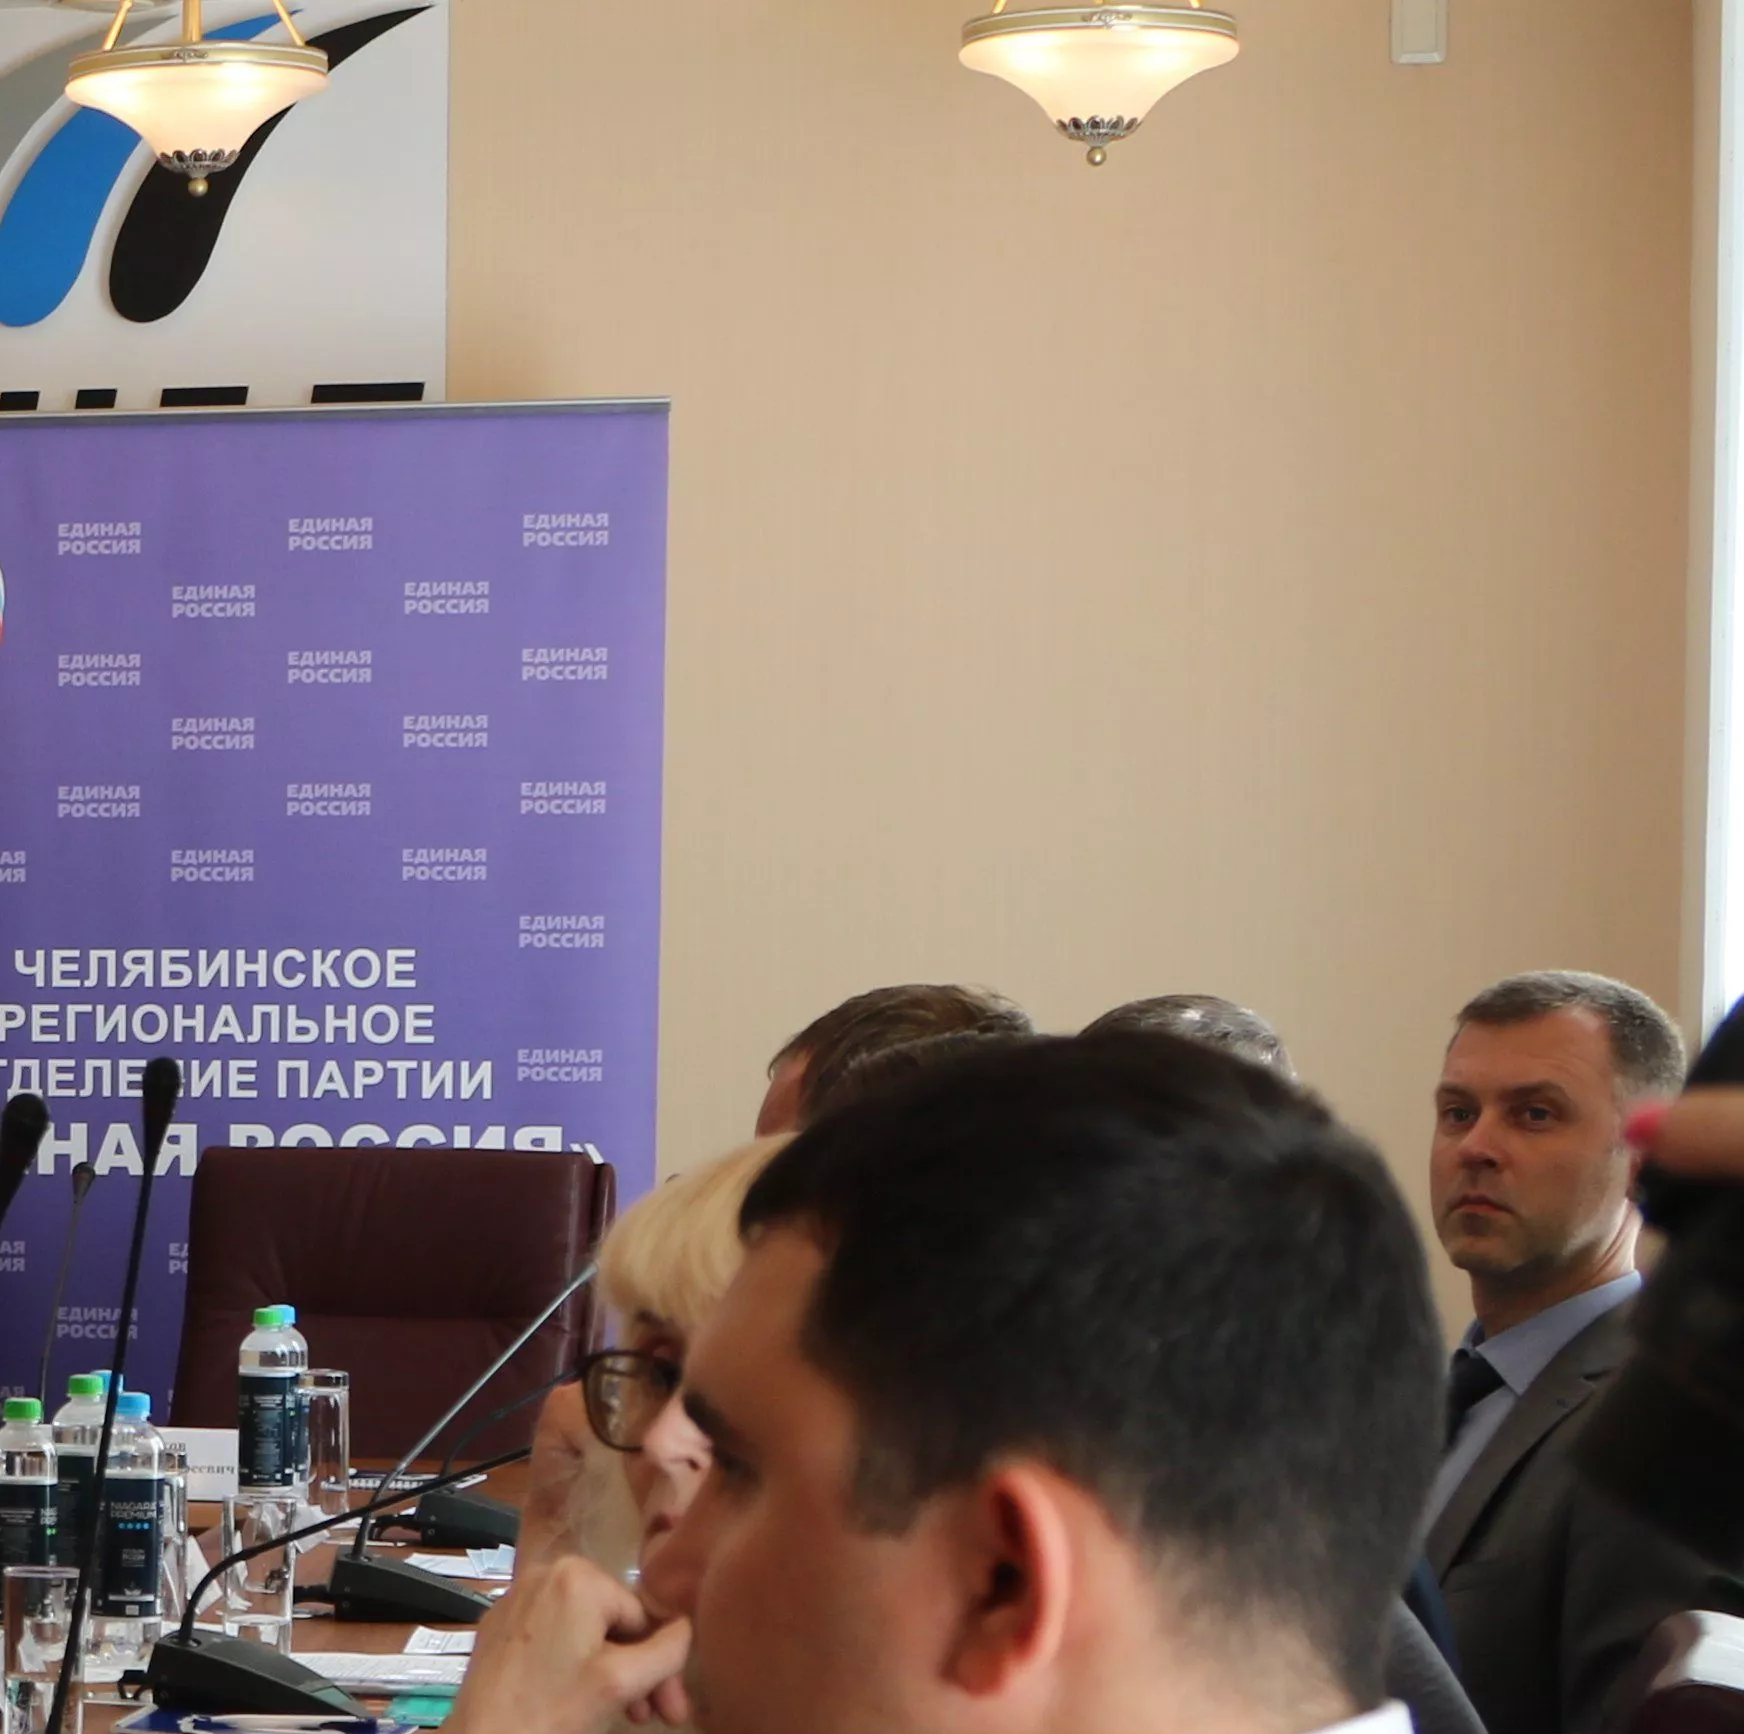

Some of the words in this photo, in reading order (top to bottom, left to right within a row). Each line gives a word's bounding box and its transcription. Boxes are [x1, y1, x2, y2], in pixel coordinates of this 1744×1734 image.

[288, 517, 373, 534] ЕДИНАЯ
[523, 512, 609, 530] ЕДИНАЯ
[58, 521, 142, 539] ЕДИНАЯ
[523, 530, 609, 547] РОССИЯ
[58, 538, 141, 555] РОССИЯ
[288, 534, 373, 551] РОССИЯ
[172, 584, 256, 601] ЕДИНАЯ
[404, 581, 490, 598] ЕДИНАЯ
[172, 601, 256, 618] РОССИЯ
[404, 598, 490, 615] РОССИЯ
[58, 653, 141, 670] ЕДИНАЯ
[287, 650, 372, 667] ЕДИНАЯ
[521, 647, 608, 664] ЕДИНАЯ
[58, 670, 141, 687] РОССИЯ
[287, 667, 372, 684] РОССИЯ
[521, 664, 608, 681] РОССИЯ
[171, 717, 255, 734] ЕДИНАЯ
[403, 714, 489, 731] ЕДИНАЯ
[171, 734, 255, 750] РОССИЯ
[403, 732, 488, 748] РОССИЯ
[57, 785, 141, 802] ЕДИНАЯ
[286, 783, 371, 799] ЕДИНАЯ
[520, 781, 607, 798] ЕДИНАЯ
[57, 802, 140, 818] РОССИЯ
[286, 800, 371, 816] РОССИЯ
[520, 798, 606, 815] РОССИЯ
[171, 849, 254, 865] ЕДИНАЯ
[402, 848, 487, 864] ЕДИНАЯ
[170, 866, 254, 882] РОССИЯ
[402, 865, 487, 881] РОССИЯ
[519, 915, 605, 931] ЕДИНАЯ
[519, 932, 605, 948] РОССИЯ
[14, 948, 417, 989] ЧЕЛЯБИНСКОЕ
[517, 1048, 604, 1065] ЕДИНАЯ
[277, 1059, 494, 1101] ПАРТИИ
[517, 1066, 603, 1082] РОССИЯ
